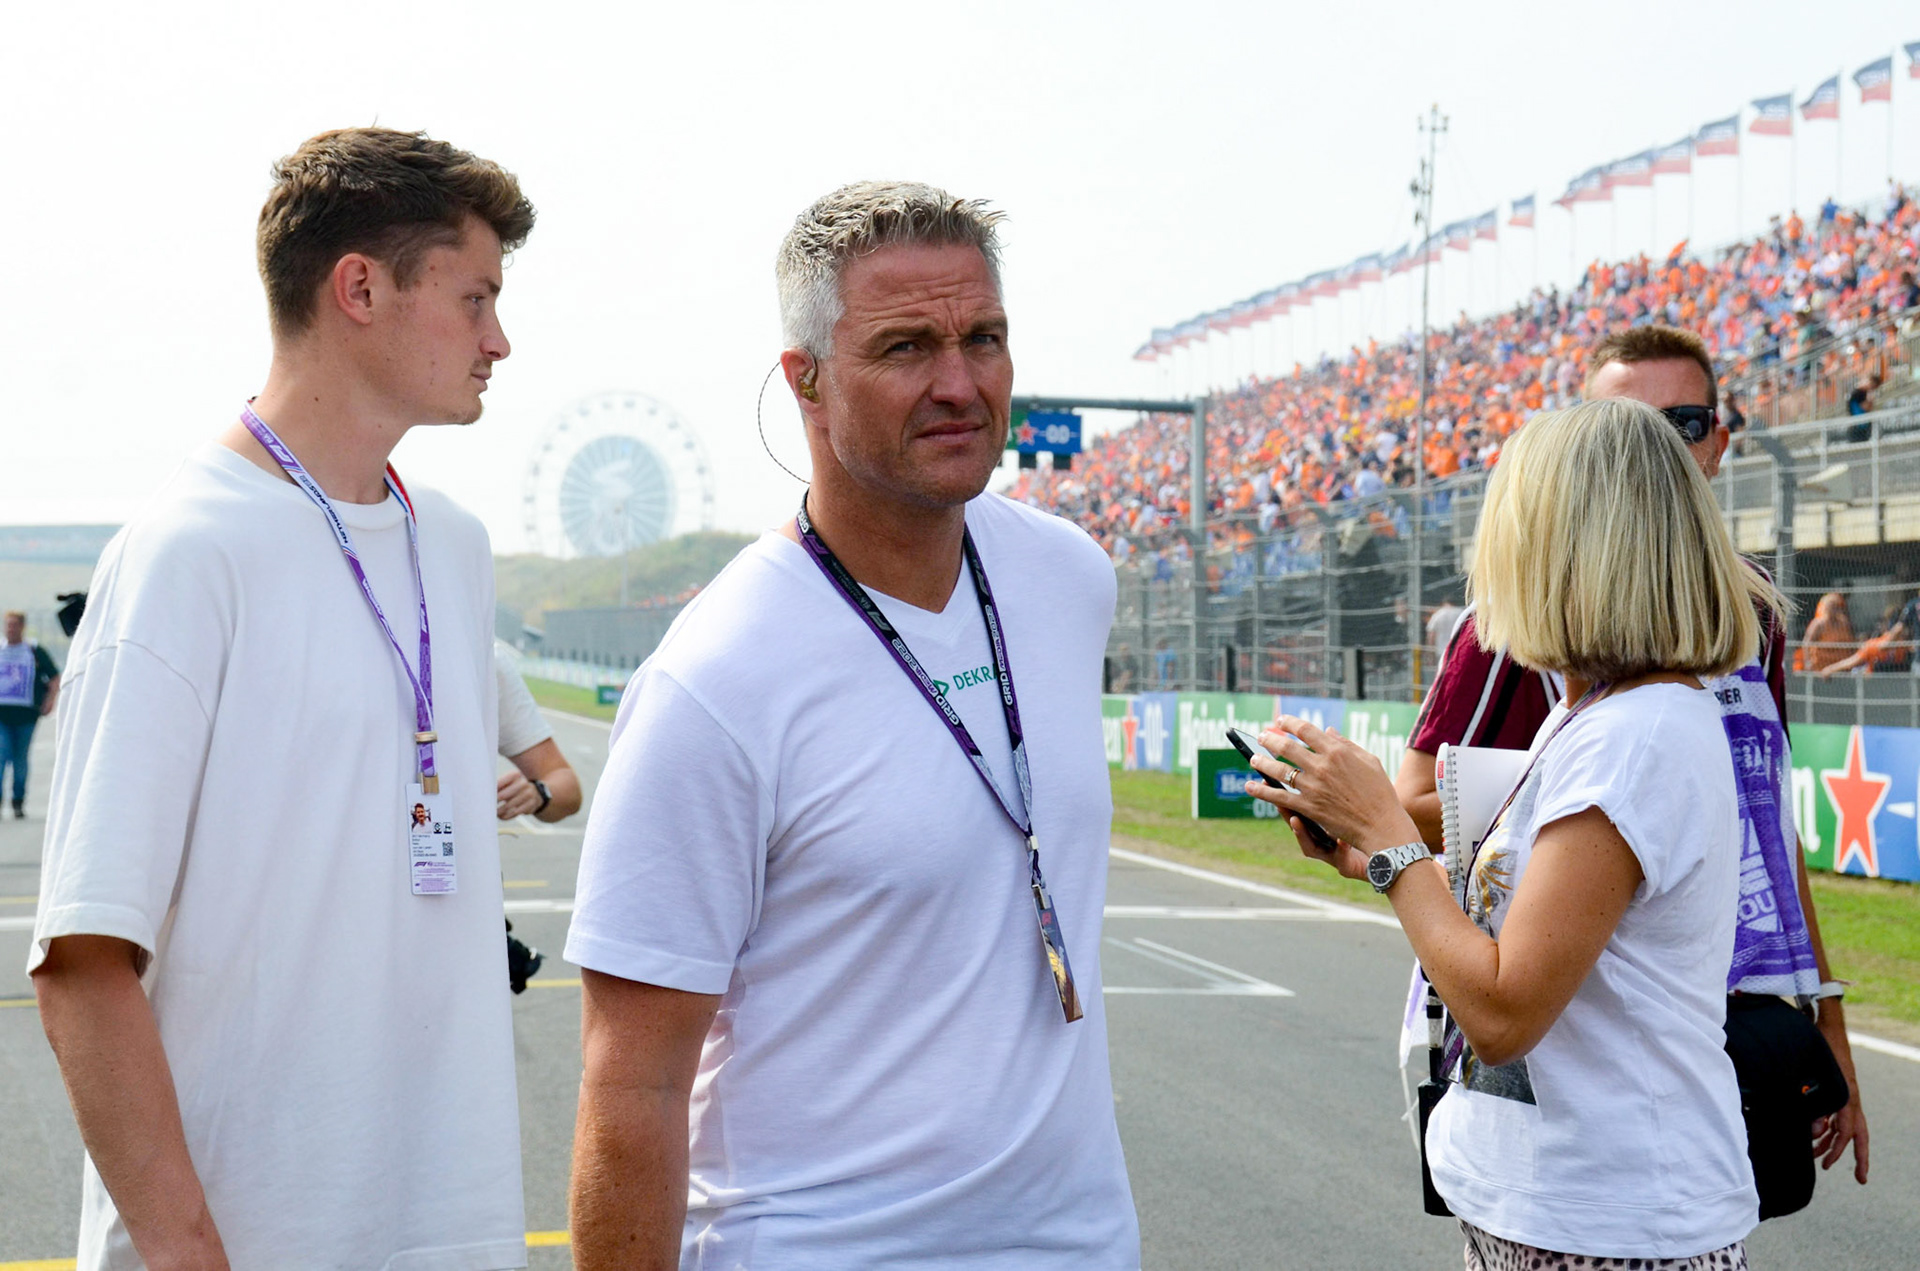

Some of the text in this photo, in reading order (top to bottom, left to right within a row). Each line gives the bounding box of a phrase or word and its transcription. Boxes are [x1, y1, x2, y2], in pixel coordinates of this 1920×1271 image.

[892, 638, 918, 669] 2022
[1000, 672, 1013, 706] GRID
[935, 695, 960, 726] GRID
